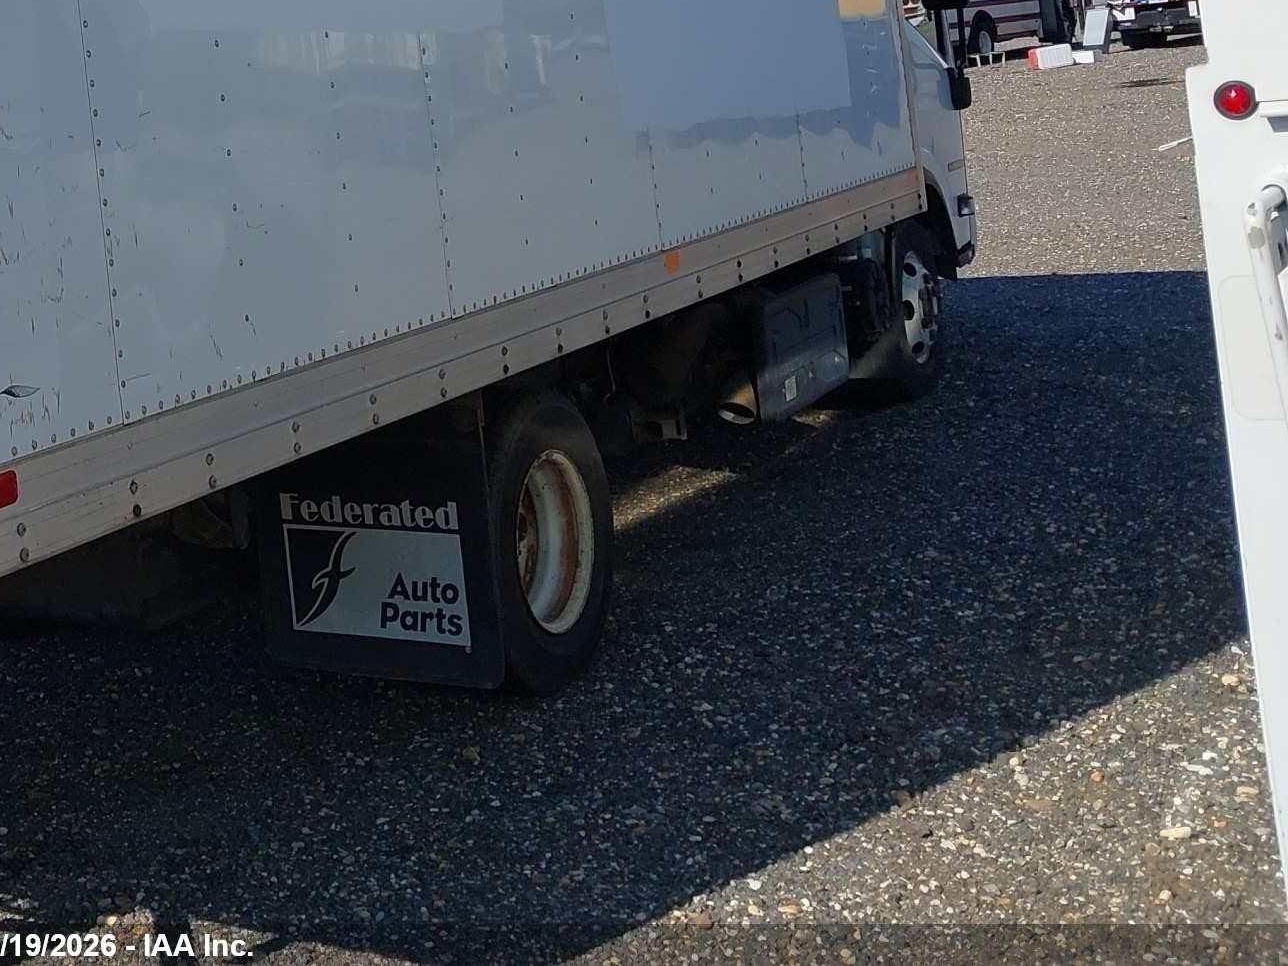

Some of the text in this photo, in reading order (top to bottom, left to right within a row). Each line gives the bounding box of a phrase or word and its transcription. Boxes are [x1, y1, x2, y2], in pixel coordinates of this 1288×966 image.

[279, 492, 459, 530] Federated
[387, 572, 460, 604] Auto
[380, 601, 463, 636] Parts
